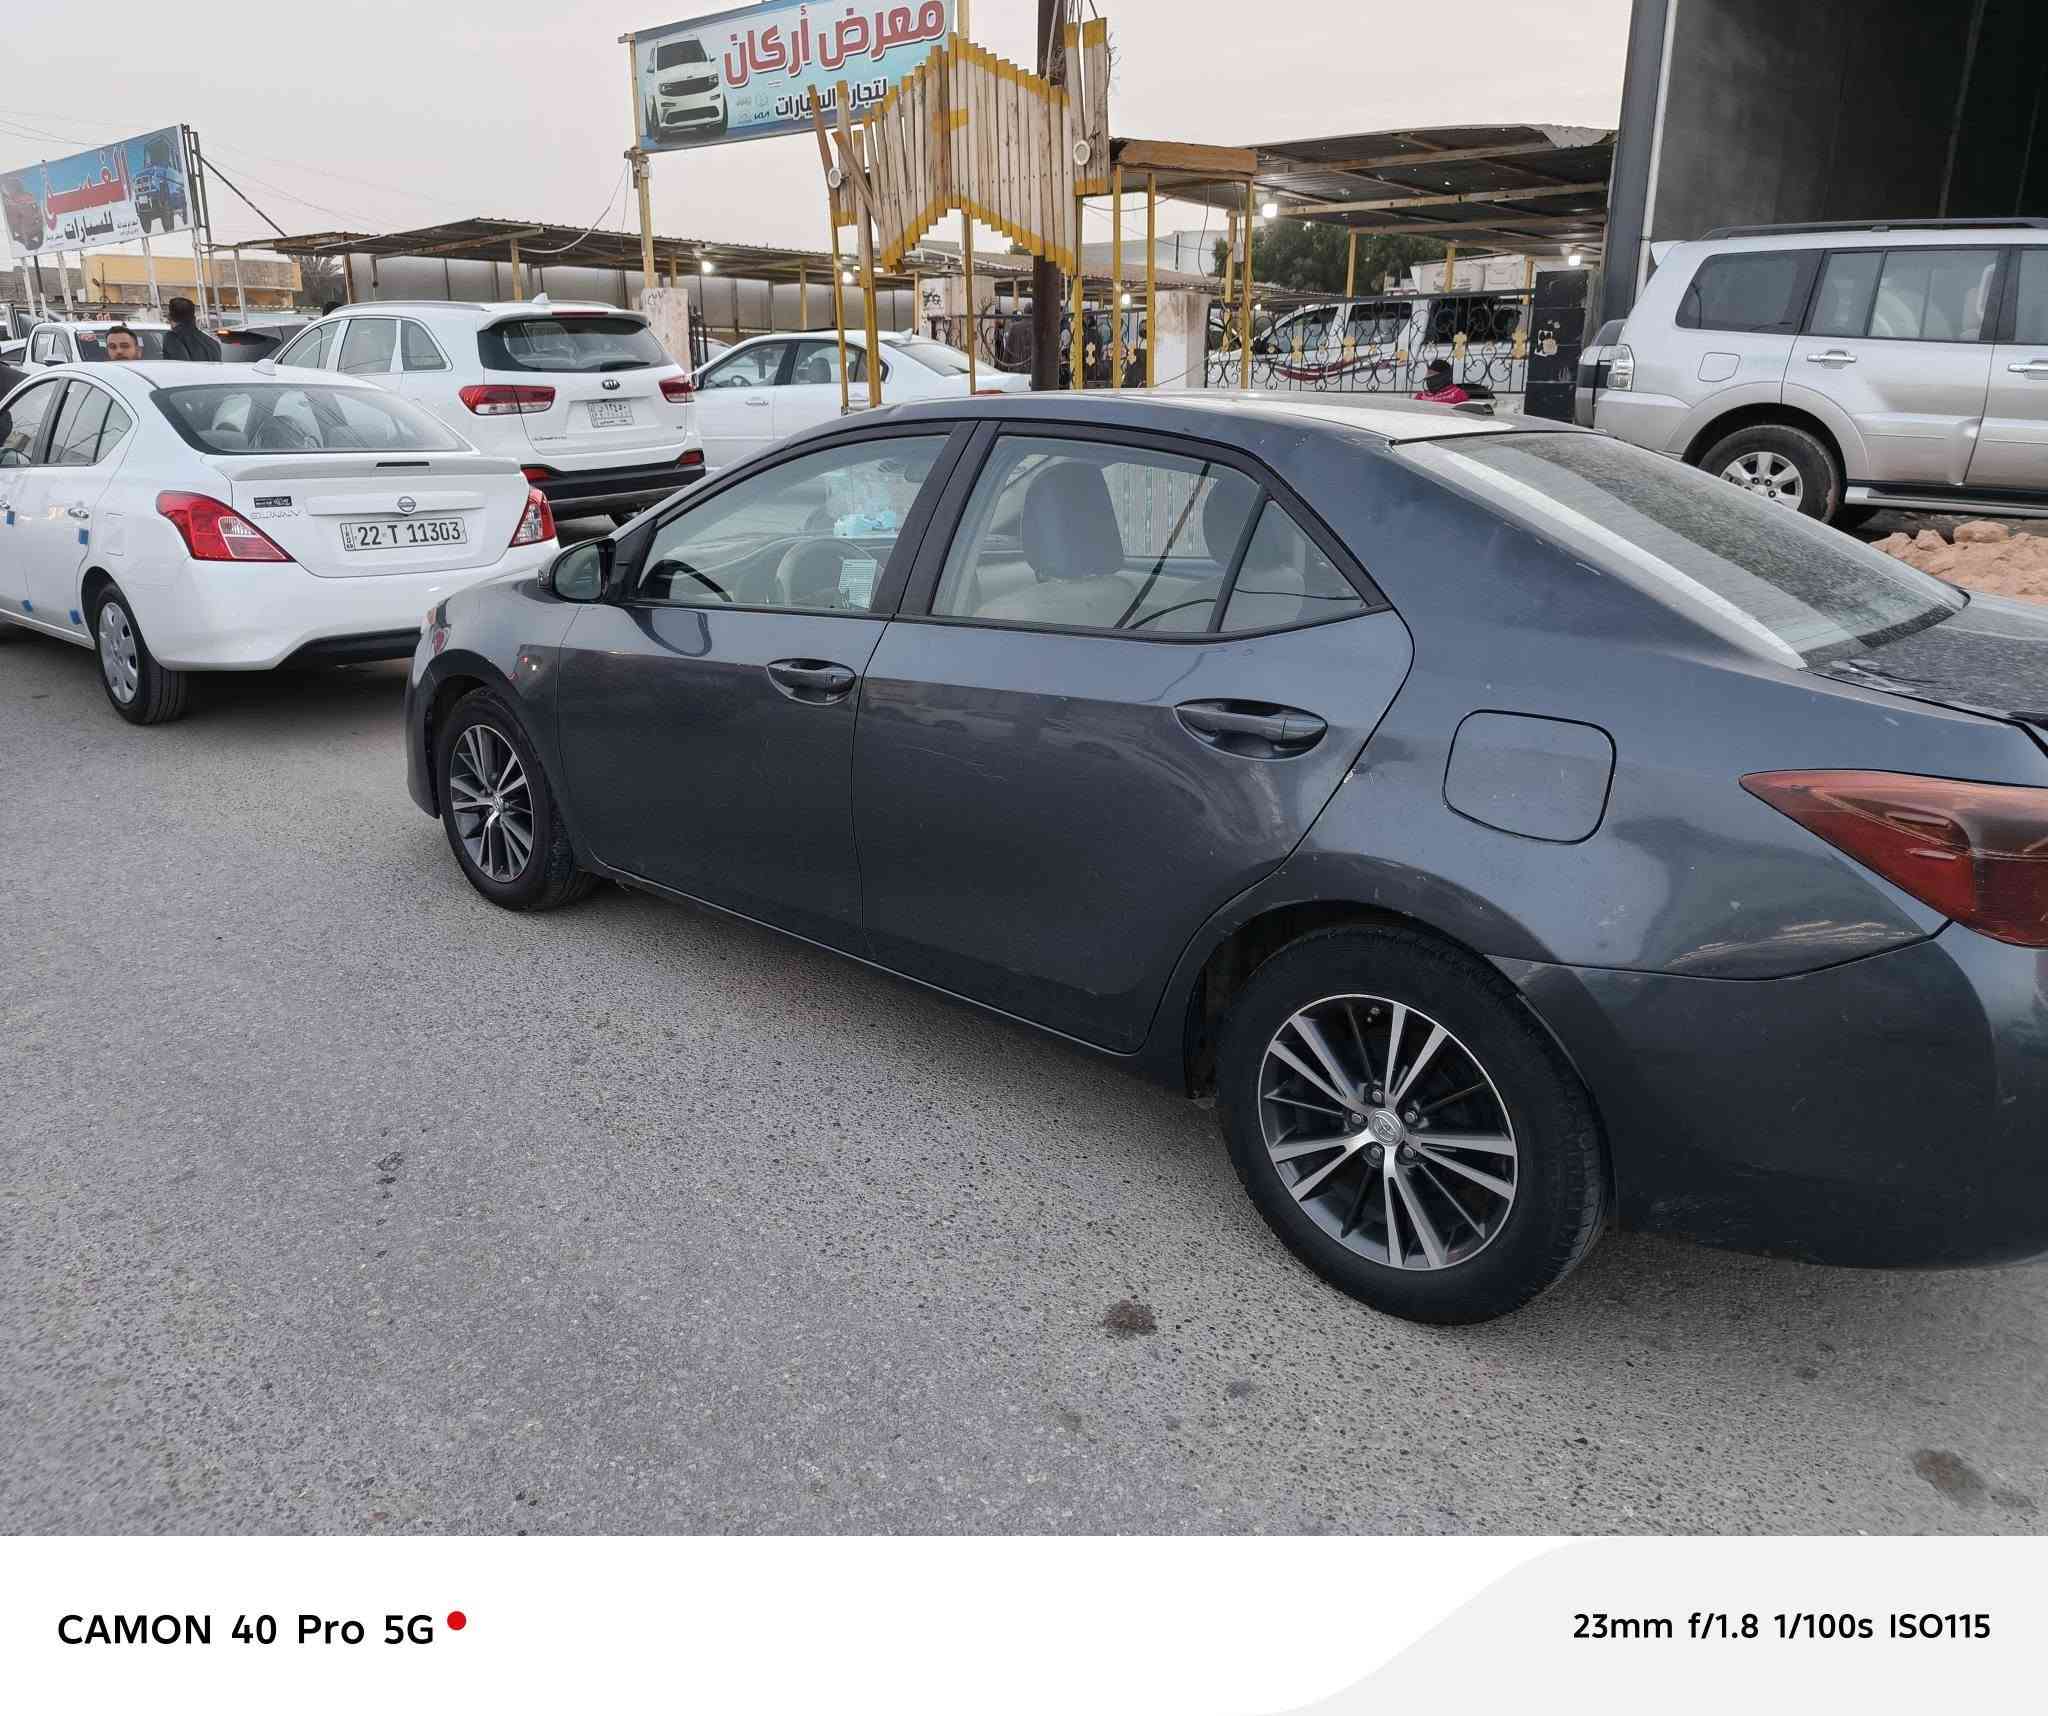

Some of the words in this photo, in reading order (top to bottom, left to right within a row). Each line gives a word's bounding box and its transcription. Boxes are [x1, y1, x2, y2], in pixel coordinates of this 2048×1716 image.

[723, 5, 811, 88] أركان
[818, 0, 946, 69] معرض
[848, 78, 888, 108] لتجار
[358, 526, 382, 547] 22
[387, 525, 398, 544] T
[406, 521, 461, 544] 11303
